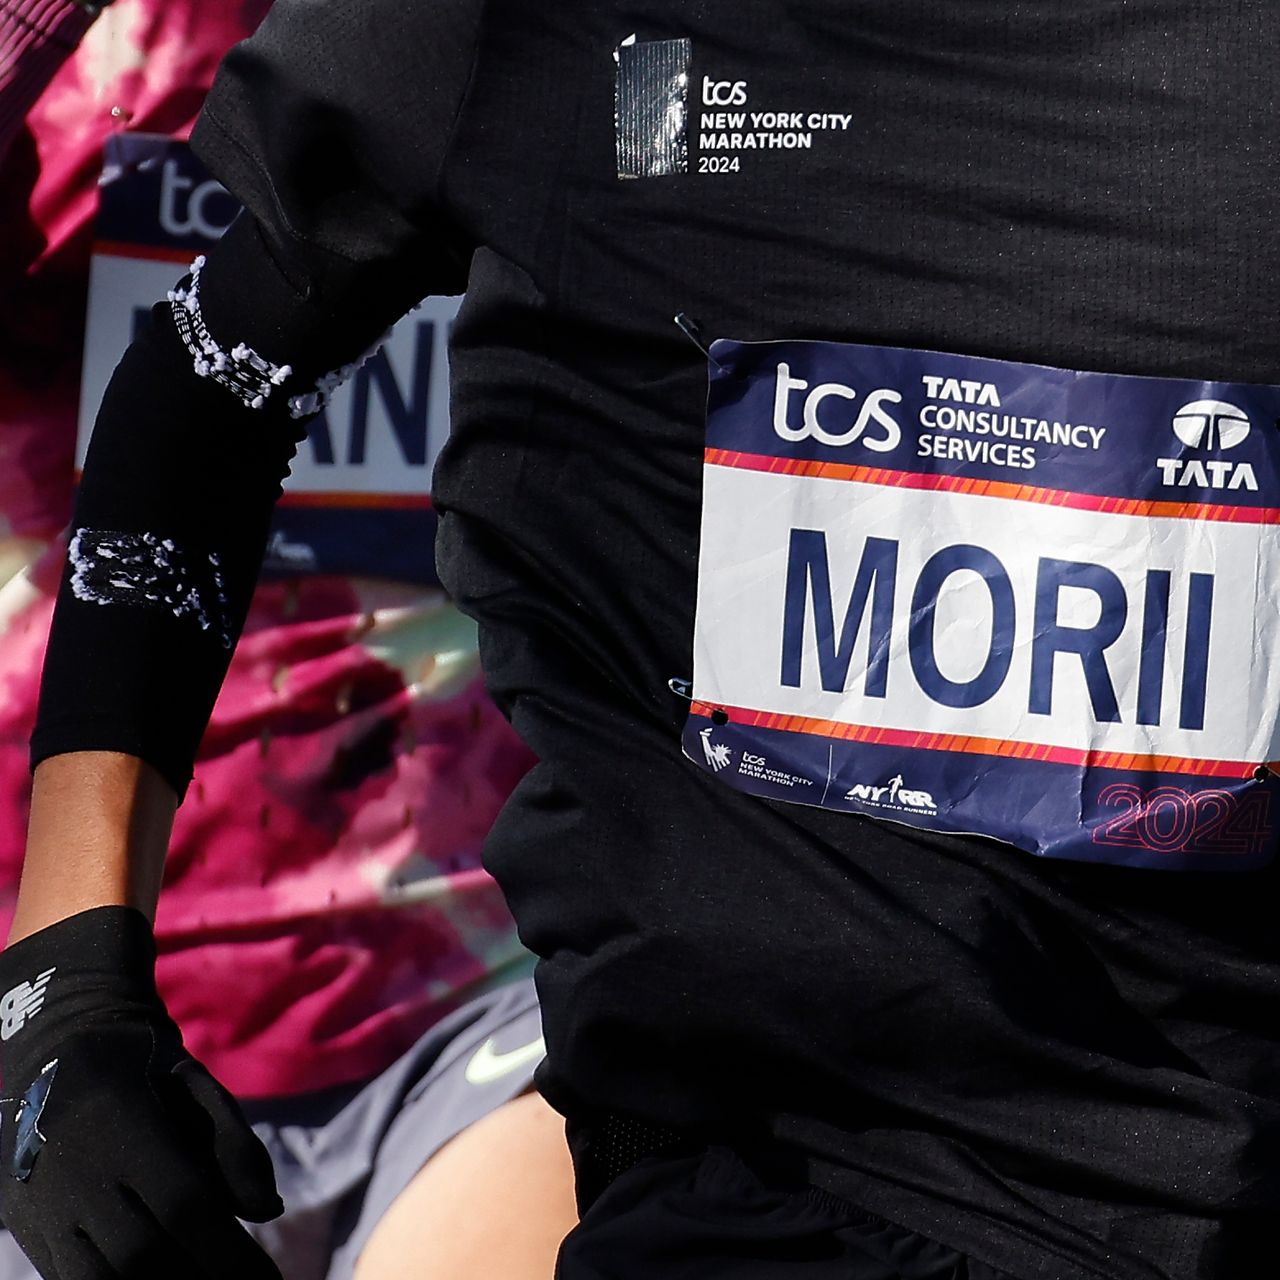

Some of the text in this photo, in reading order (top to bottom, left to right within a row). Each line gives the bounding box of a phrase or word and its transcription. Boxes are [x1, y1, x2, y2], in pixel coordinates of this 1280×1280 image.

[701, 75, 748, 106] tcs
[700, 112, 852, 130] NEW YORK CITY
[699, 132, 812, 150] MARATHON
[698, 156, 740, 173] 2024
[159, 159, 233, 239] tc
[773, 362, 903, 452] tcs
[922, 375, 1001, 407] TATA
[919, 405, 1107, 450] CONSULTANCY
[917, 434, 1037, 469] SERVICES
[1156, 458, 1259, 491] TATA
[780, 527, 1215, 732] MORII
[740, 762, 813, 786] NEW YORK CITY
[742, 751, 766, 766] tcs
[738, 767, 794, 787] MARATHON
[1091, 783, 1273, 854] 2024
